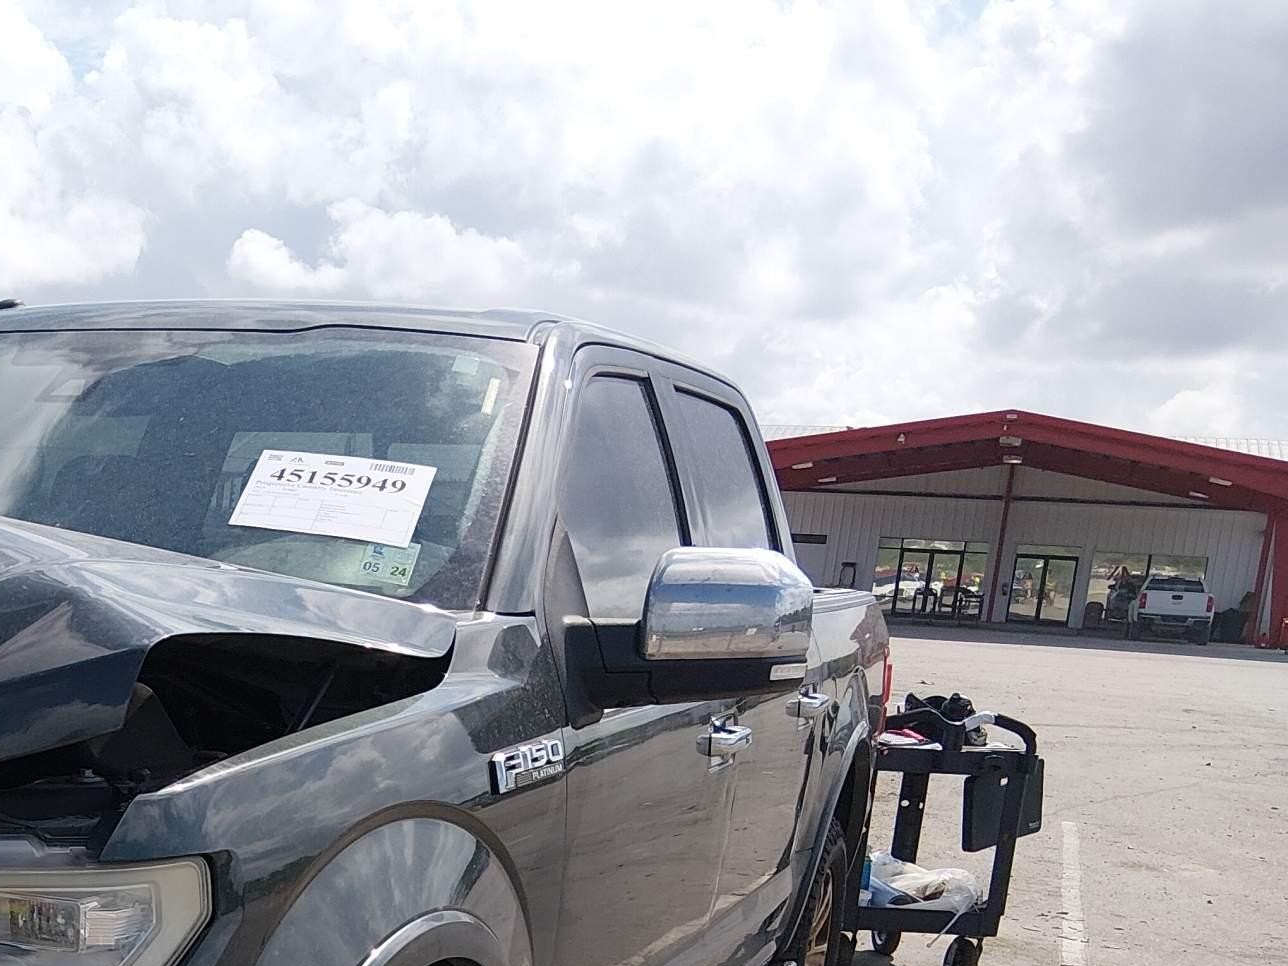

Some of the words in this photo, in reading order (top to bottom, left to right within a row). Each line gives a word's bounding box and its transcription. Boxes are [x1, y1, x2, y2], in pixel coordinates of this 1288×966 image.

[269, 467, 407, 494] 45155949
[362, 560, 381, 573] 05
[390, 565, 408, 578] 24
[532, 763, 564, 781] PLATINUM
